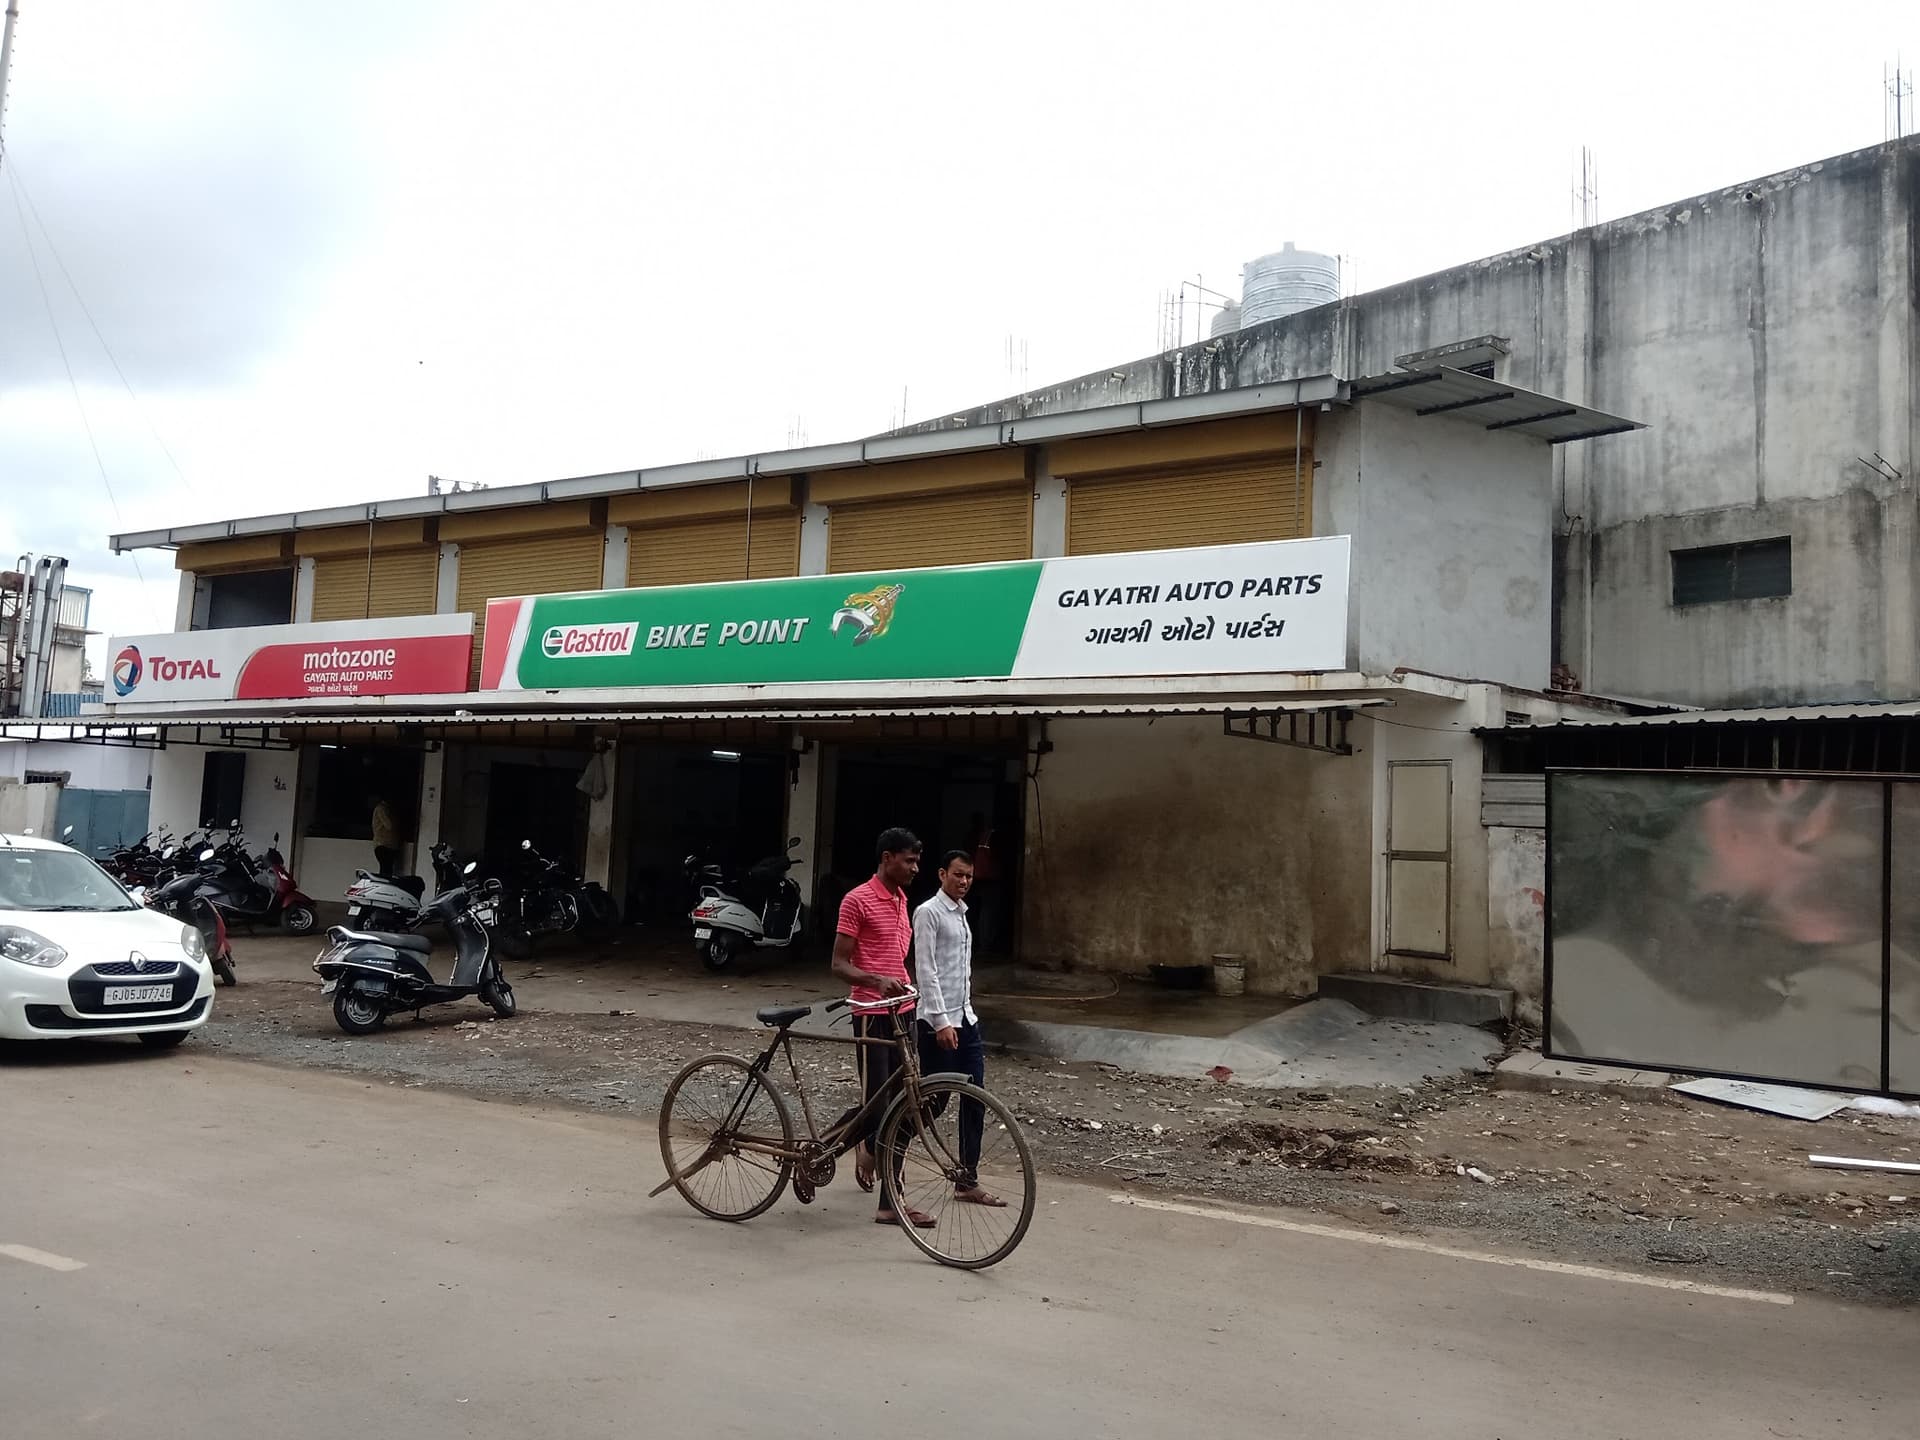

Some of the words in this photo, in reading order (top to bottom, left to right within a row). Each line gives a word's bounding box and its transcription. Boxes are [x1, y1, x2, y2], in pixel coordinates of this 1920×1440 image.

[1058, 585, 1160, 608] GAYATRI
[1166, 580, 1233, 602] AUTO
[1240, 574, 1322, 598] PARTS
[564, 626, 631, 654] Castrol
[646, 623, 709, 650] BIKE
[718, 618, 810, 646] POINT
[1085, 618, 1152, 645] ગાયત્રી
[1161, 615, 1215, 641] ઓટો
[303, 647, 396, 669] motozone
[303, 672, 338, 683] GAYATRI
[339, 671, 364, 682] AUTO
[366, 670, 393, 680] PARTS
